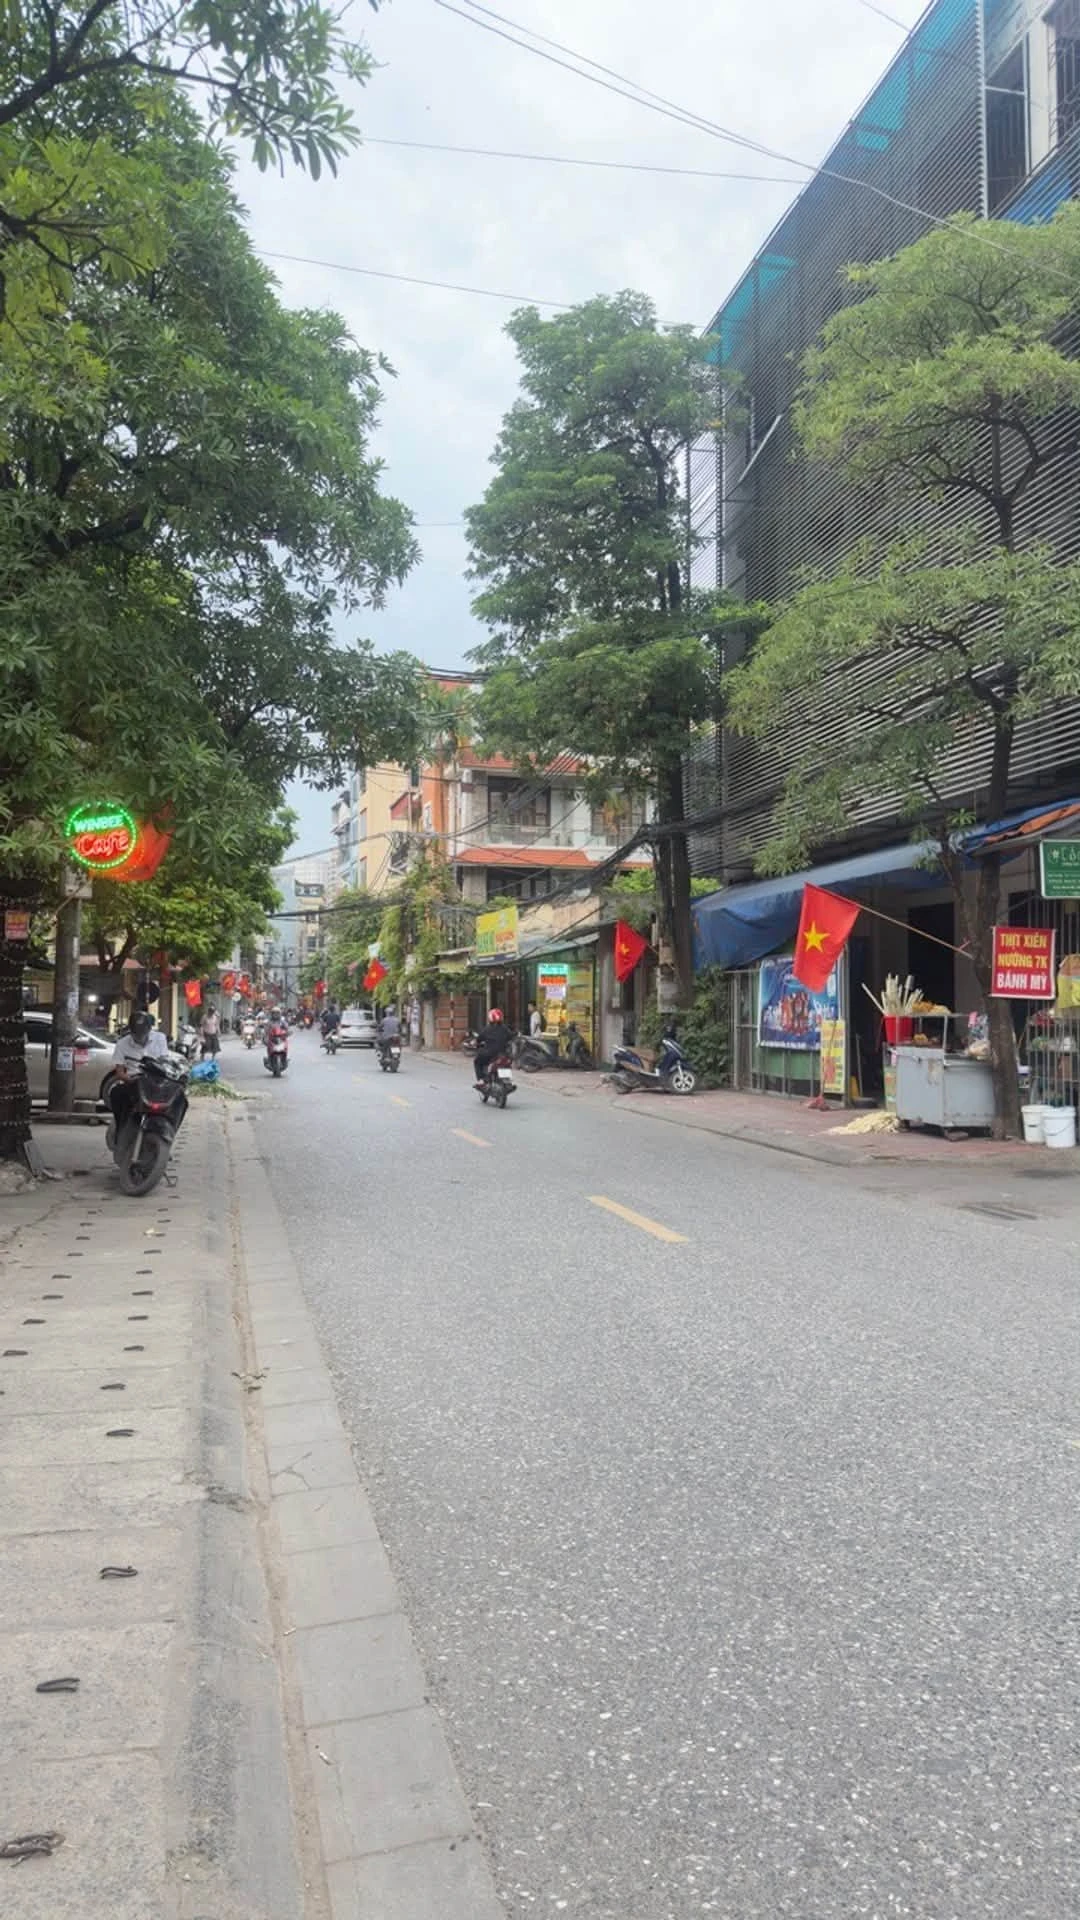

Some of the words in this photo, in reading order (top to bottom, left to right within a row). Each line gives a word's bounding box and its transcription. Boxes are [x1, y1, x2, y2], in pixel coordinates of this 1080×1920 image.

[1000, 933, 1020, 950] THỊT
[1034, 955, 1048, 968] 7K
[997, 970, 1028, 989] BÁNH
